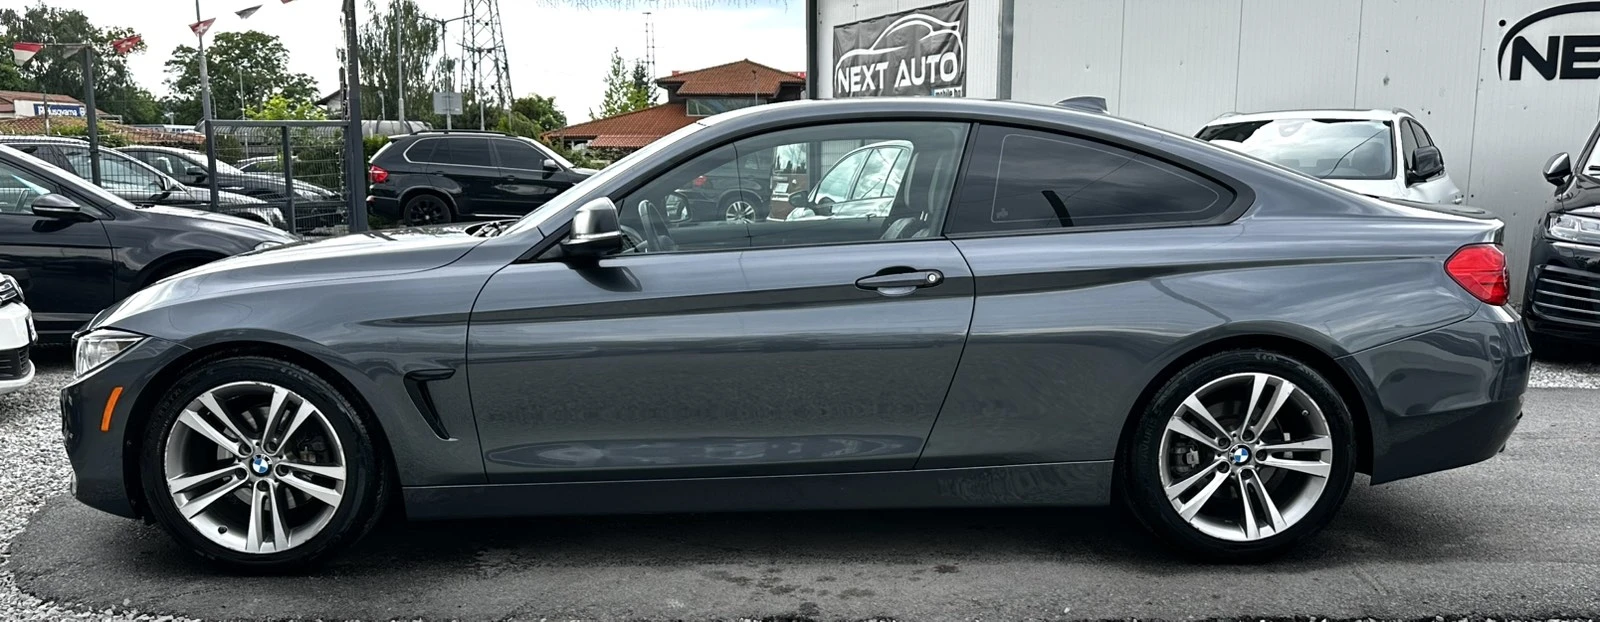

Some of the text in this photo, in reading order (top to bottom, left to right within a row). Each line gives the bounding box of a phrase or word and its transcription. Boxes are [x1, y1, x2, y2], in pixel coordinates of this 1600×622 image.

[837, 51, 958, 94] NEXT AUTO
[1509, 35, 1600, 81] NE
